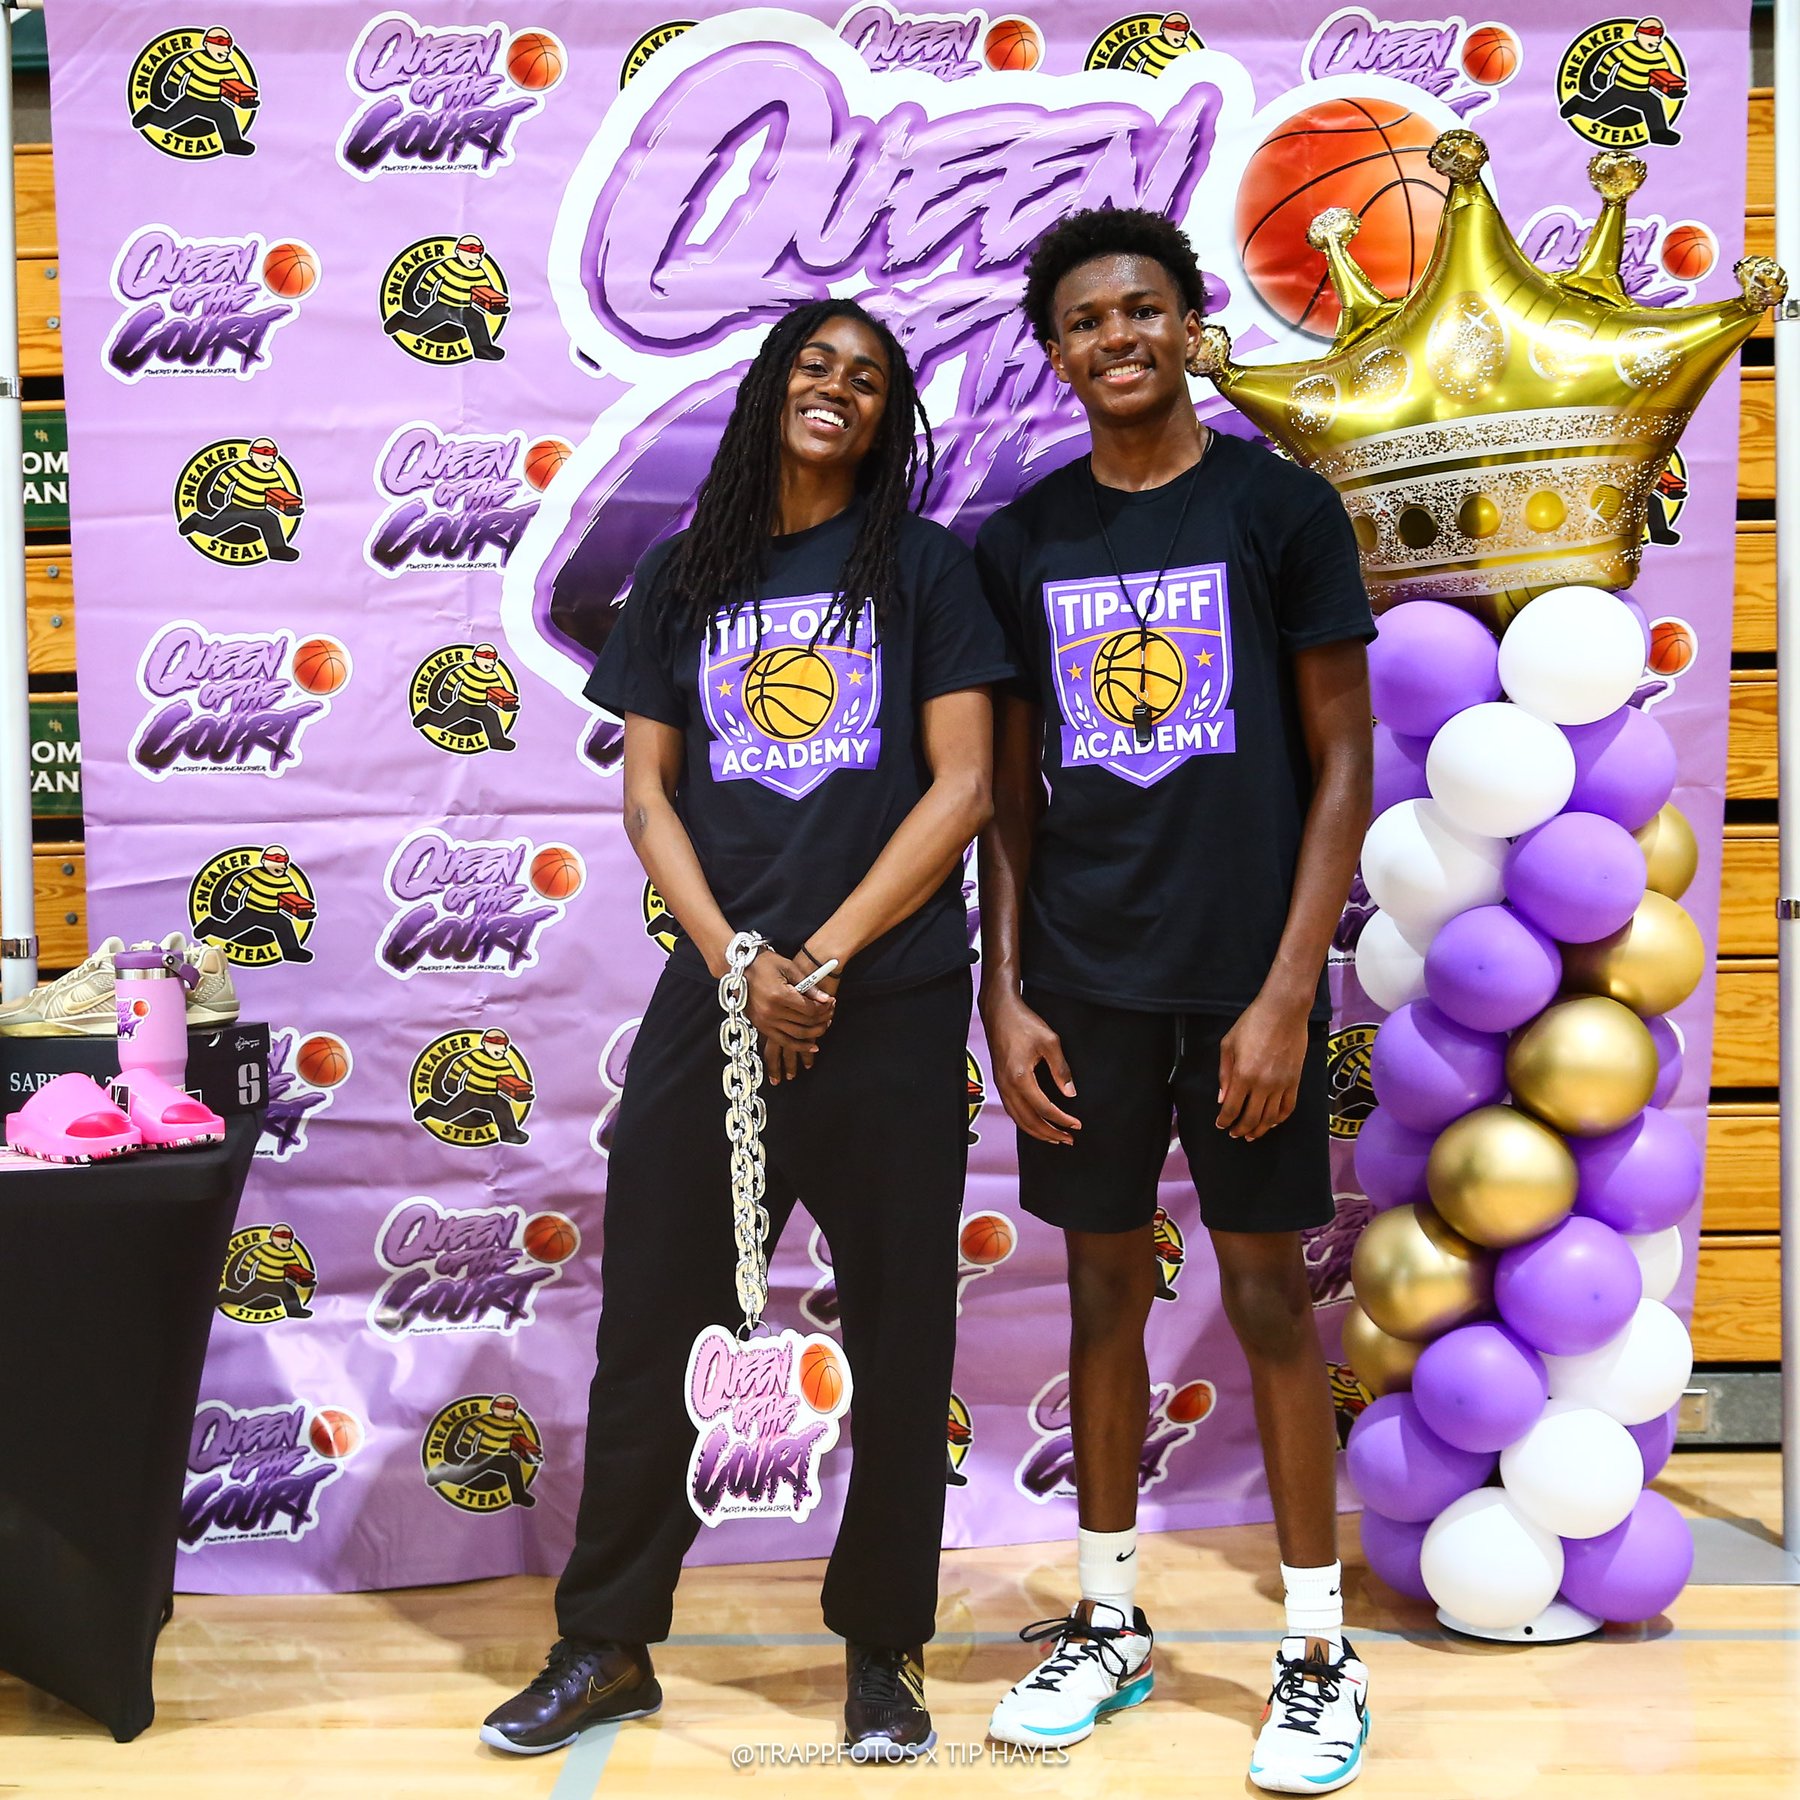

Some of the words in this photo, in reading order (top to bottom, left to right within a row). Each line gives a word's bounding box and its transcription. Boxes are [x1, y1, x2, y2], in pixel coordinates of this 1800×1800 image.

[134, 33, 193, 100] SNEAKER
[354, 18, 500, 92] QUEEN
[840, 6, 981, 73] QUEEN
[1092, 21, 1150, 70] NEAKER
[1309, 14, 1459, 80] QUEEN
[1564, 26, 1624, 89] SNEAKER
[161, 132, 219, 152] STEAL
[342, 95, 537, 172] COURT
[1589, 122, 1644, 143] STEAL
[578, 40, 1223, 358] QUEEN
[117, 230, 258, 301] QUEEN
[387, 243, 445, 306] SNEAKER
[108, 302, 293, 376] COURT
[413, 337, 468, 359] STEAL
[182, 446, 239, 508] SNEAKER
[380, 428, 518, 496] QUEEN
[207, 539, 263, 560] STEAL
[1057, 580, 1211, 637] TIP-OFF
[144, 627, 287, 698] QUEEN
[416, 650, 465, 704] SNEAKER
[135, 699, 323, 774] COURT
[437, 730, 486, 749] STEAL
[721, 737, 871, 775] ACADEMY
[1072, 721, 1225, 761] ACADEMY
[30, 770, 80, 793] AN
[196, 852, 251, 913] SNEAKER
[391, 834, 525, 901] QUEEN
[224, 942, 278, 963] STEAL
[382, 902, 558, 972] COURT
[417, 1036, 472, 1094] SNEAKER
[441, 1123, 495, 1142] STEAL
[382, 1203, 519, 1268] QUEEN
[235, 1307, 282, 1319] STEAL
[374, 1267, 555, 1335] COURT
[691, 1334, 793, 1421] QUEEN
[188, 1406, 305, 1474] QUEEN
[429, 1402, 481, 1460] SNEAKER
[454, 1486, 508, 1507] STEAL
[692, 1420, 829, 1516] COURT
[178, 1463, 337, 1546] COURT
